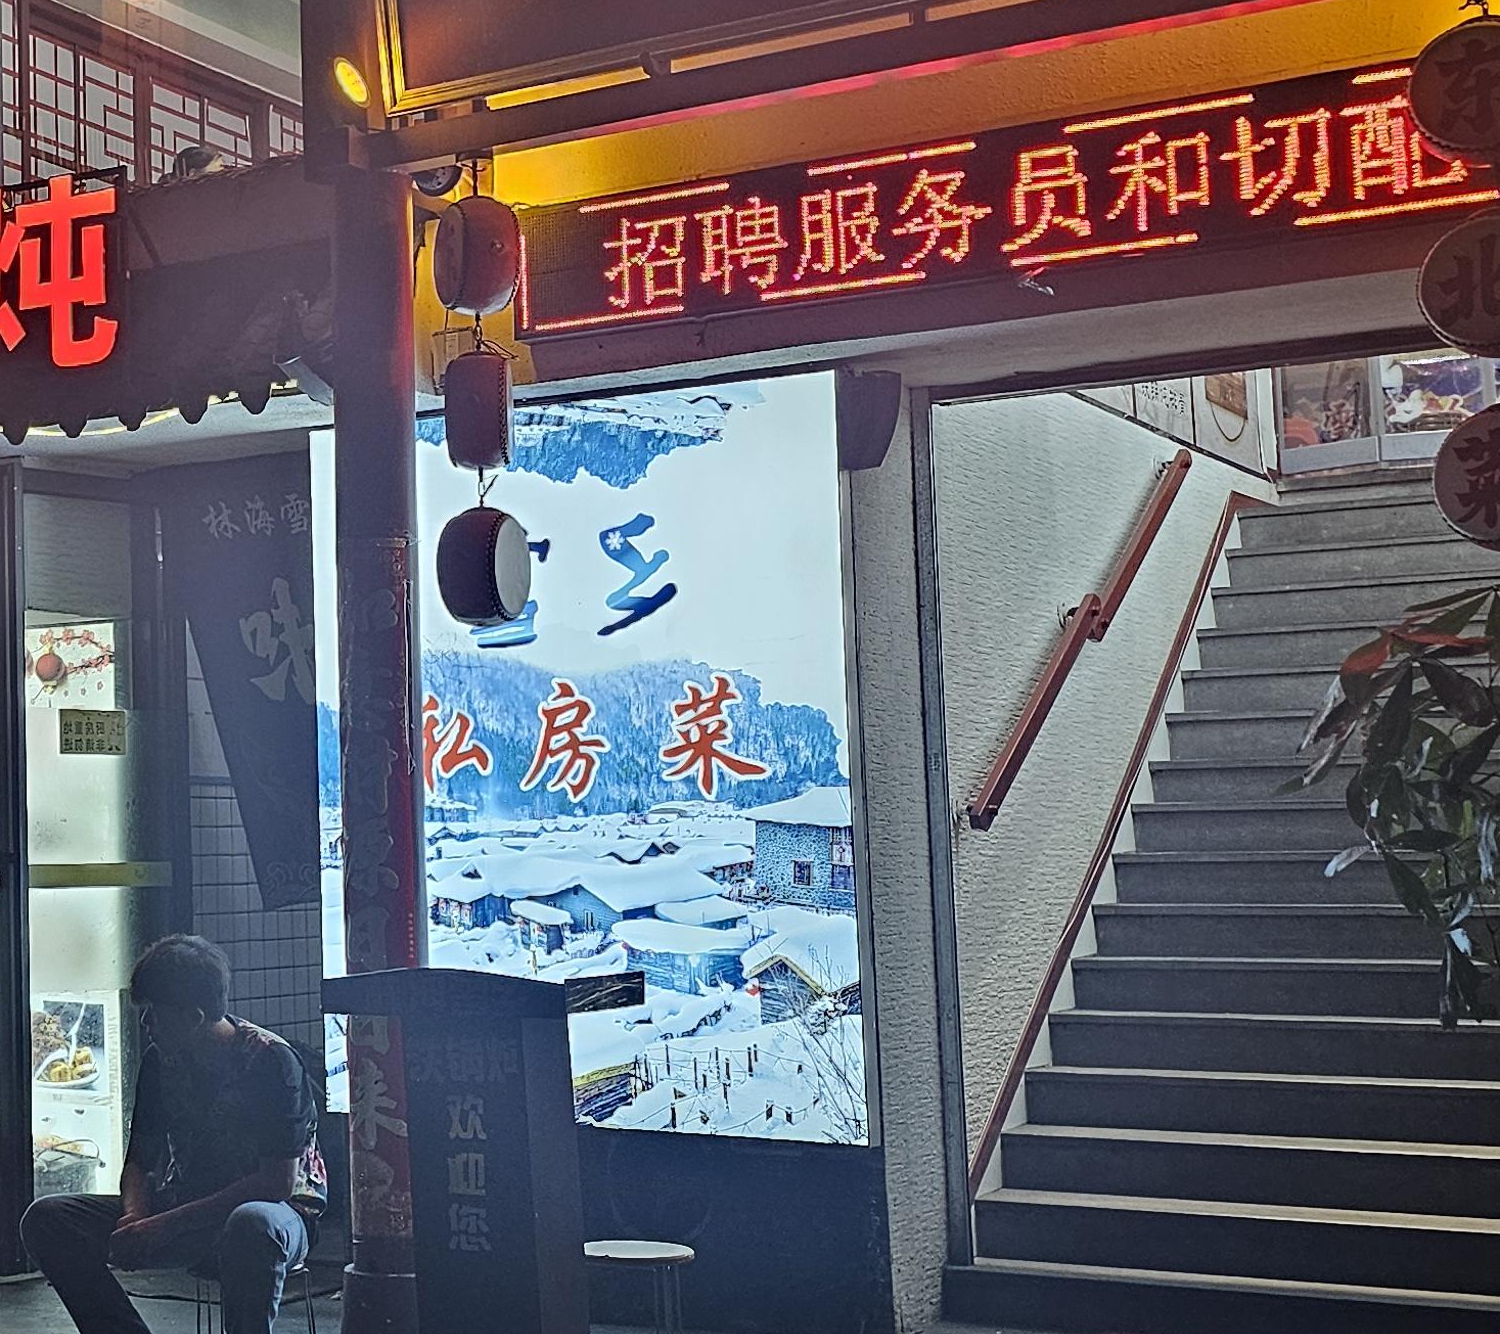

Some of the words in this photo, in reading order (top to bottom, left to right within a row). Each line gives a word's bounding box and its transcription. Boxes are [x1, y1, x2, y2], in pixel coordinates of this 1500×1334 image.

[603, 98, 1468, 309] 招聘服务员和切配
